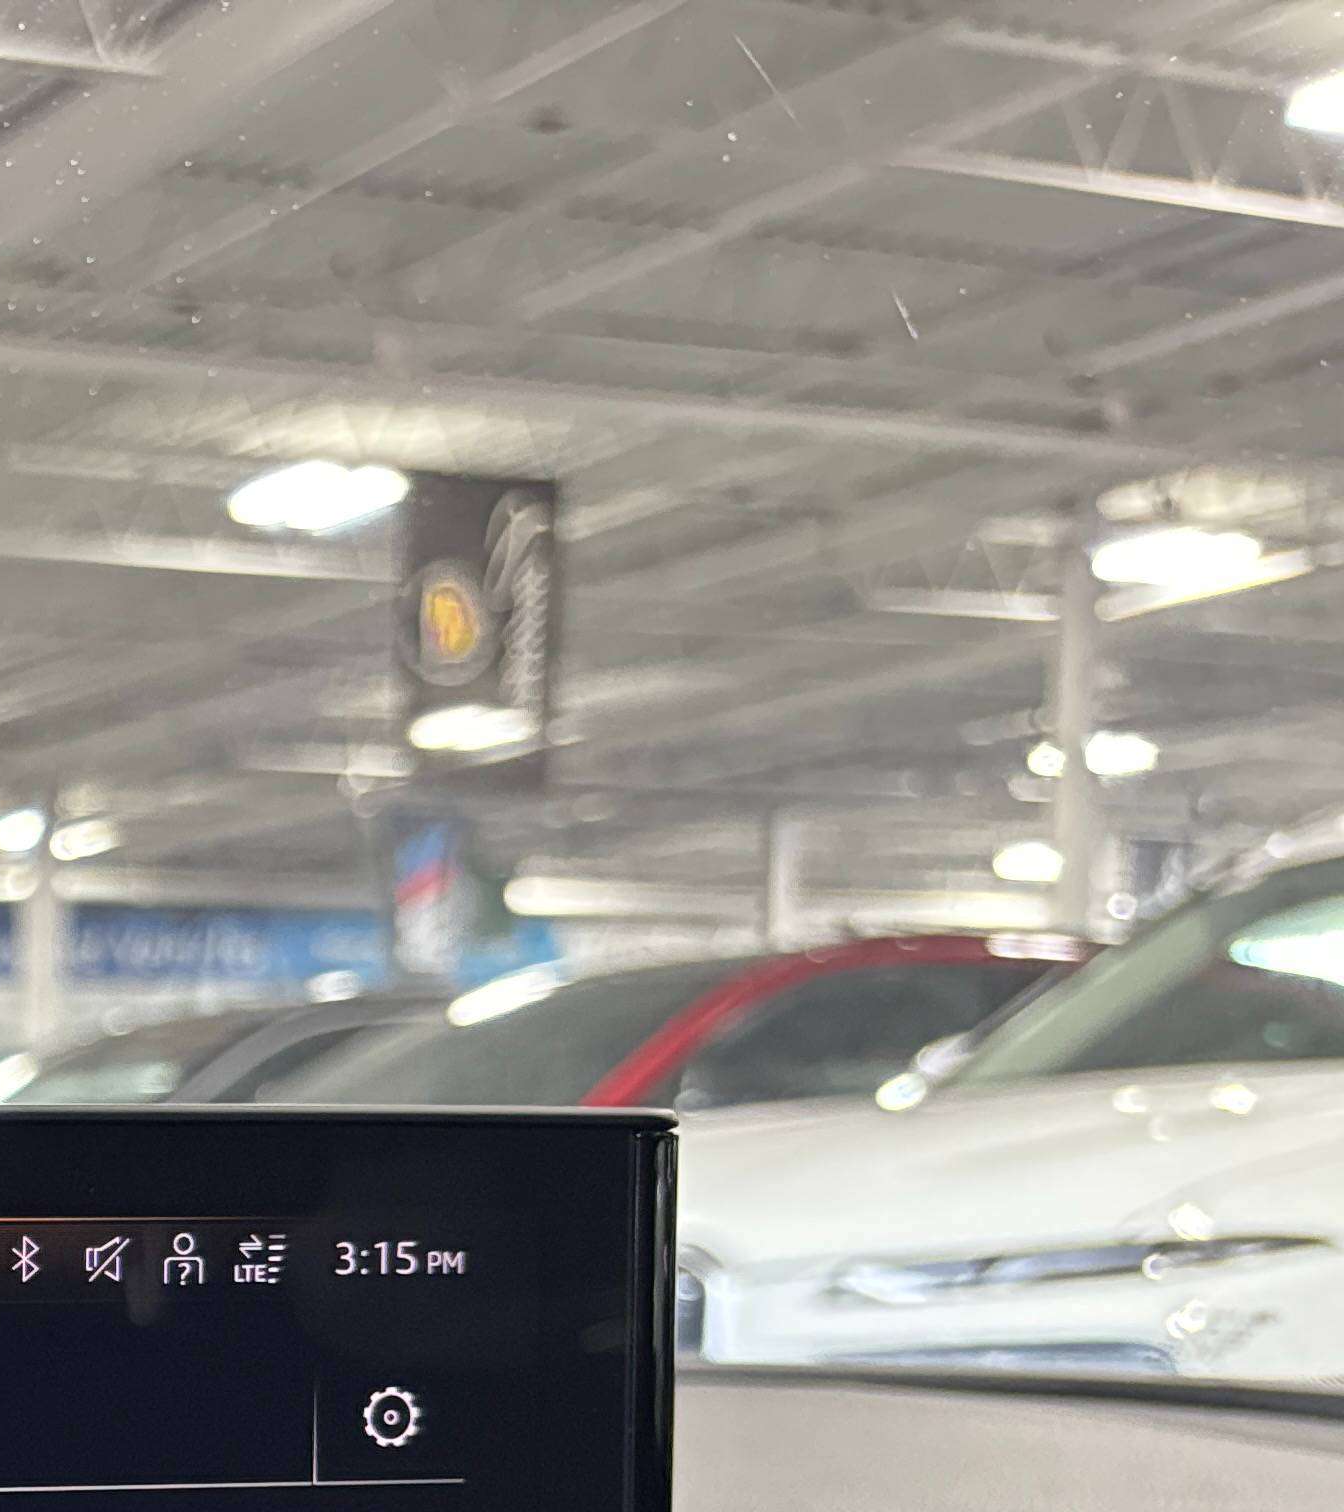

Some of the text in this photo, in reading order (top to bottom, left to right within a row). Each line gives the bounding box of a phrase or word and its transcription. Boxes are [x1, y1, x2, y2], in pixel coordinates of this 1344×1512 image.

[335, 1241, 467, 1277] 3:15 PM
[233, 1264, 268, 1284] LTE
